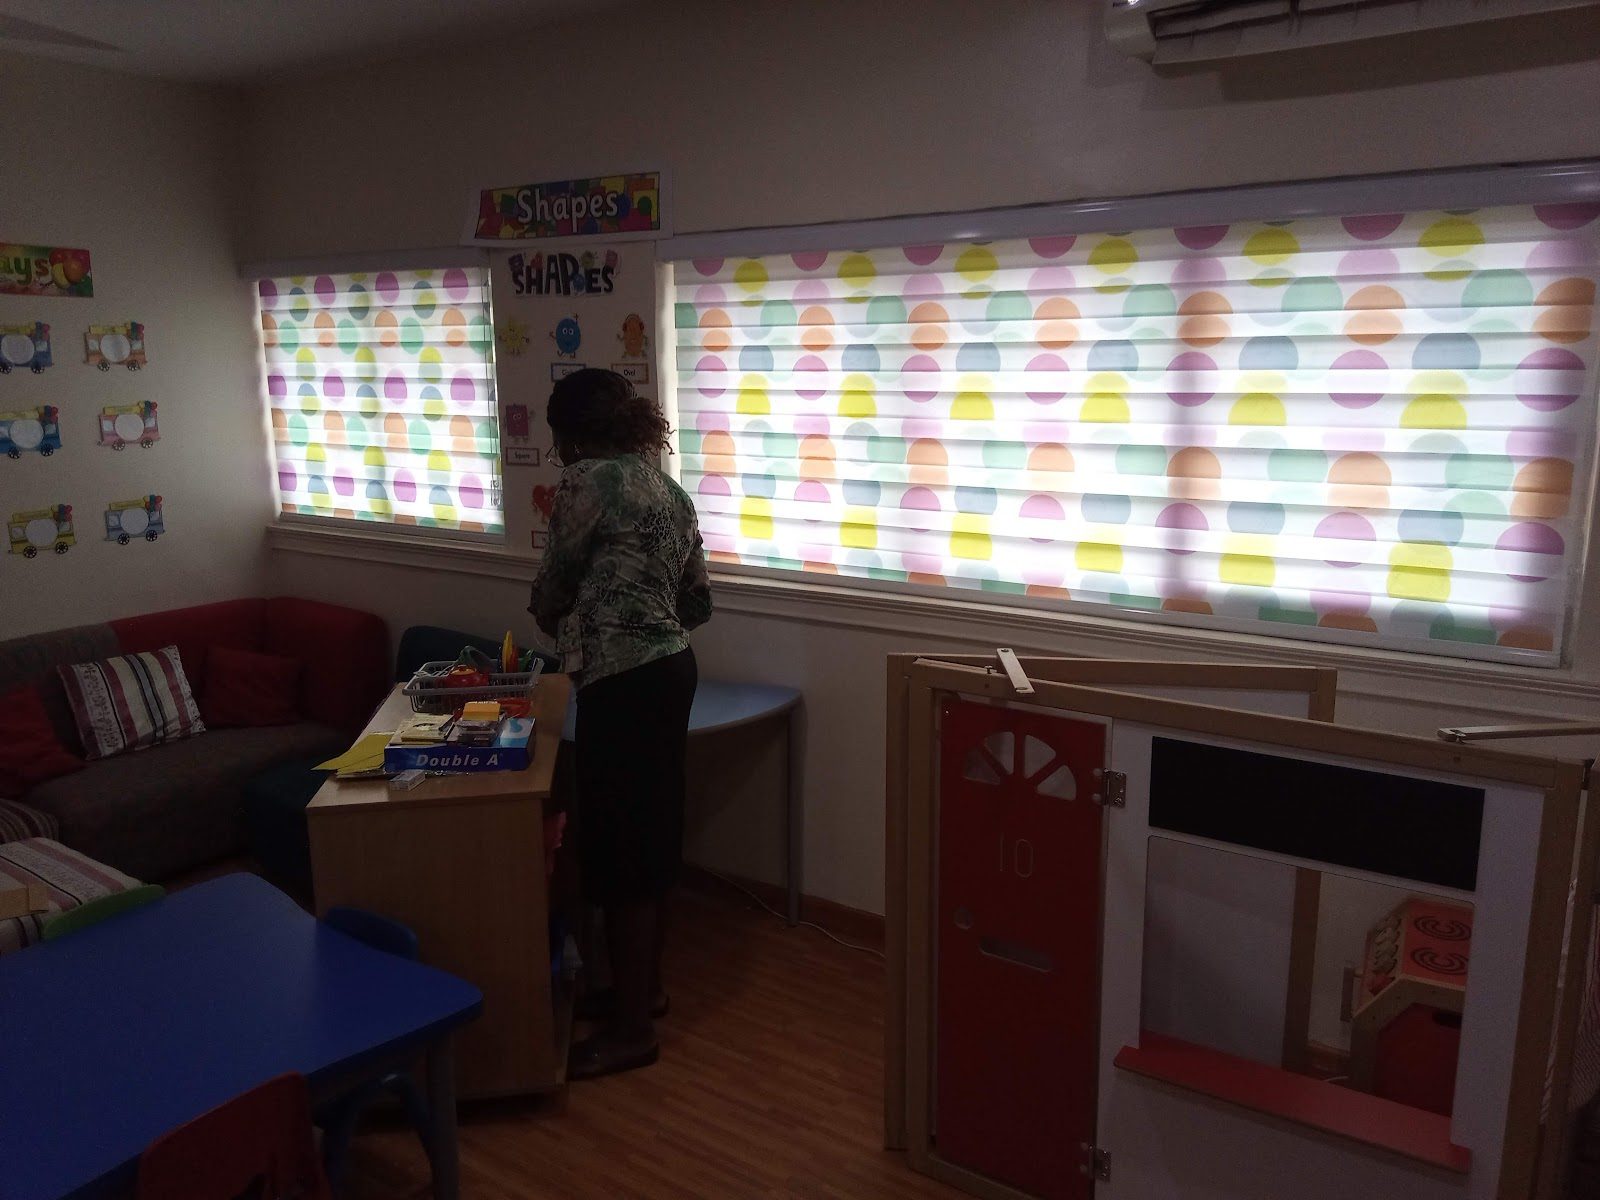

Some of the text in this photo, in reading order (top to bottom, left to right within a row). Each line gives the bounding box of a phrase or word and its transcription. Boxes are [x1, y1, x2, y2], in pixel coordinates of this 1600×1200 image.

[517, 187, 620, 233] Shapes
[510, 252, 615, 295] SHAPES
[415, 753, 499, 766] Double A
